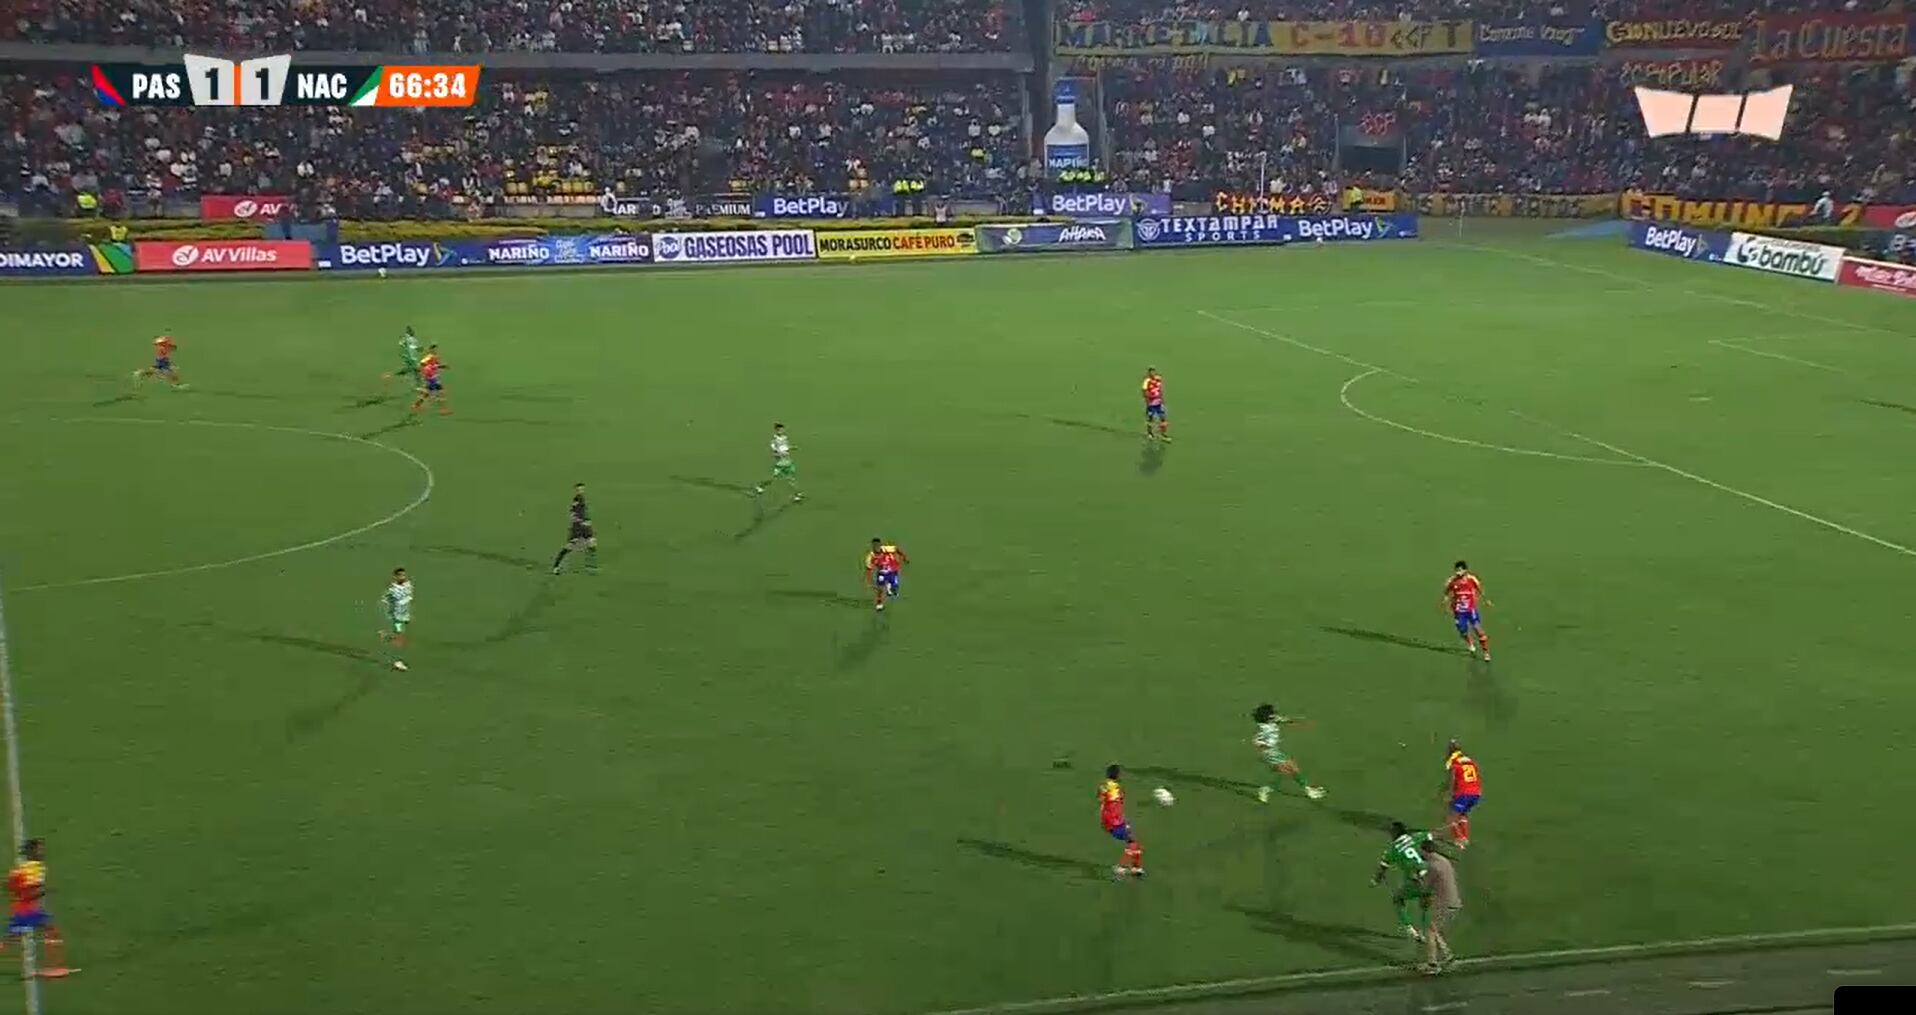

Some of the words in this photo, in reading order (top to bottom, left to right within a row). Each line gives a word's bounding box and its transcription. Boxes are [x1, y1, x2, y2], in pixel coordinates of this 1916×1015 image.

[773, 197, 849, 217] BetPlay
[1052, 194, 1126, 215] BetPlay
[1185, 230, 1261, 242] SPORTS
[1299, 217, 1373, 239] BetPlay
[589, 243, 649, 257] NARIÑO
[684, 235, 768, 258] GASEOSAS
[771, 234, 813, 256] POOL
[820, 238, 891, 250] MORASURCO
[892, 232, 924, 250] CAFÉ
[924, 235, 955, 248] PURO
[1646, 226, 1697, 257] BetPlay
[226, 246, 277, 262] Villas
[339, 243, 431, 267] BetPlay
[488, 244, 550, 260] NARIÑO
[1760, 245, 1828, 275] bambú
[1462, 764, 1477, 782] 21
